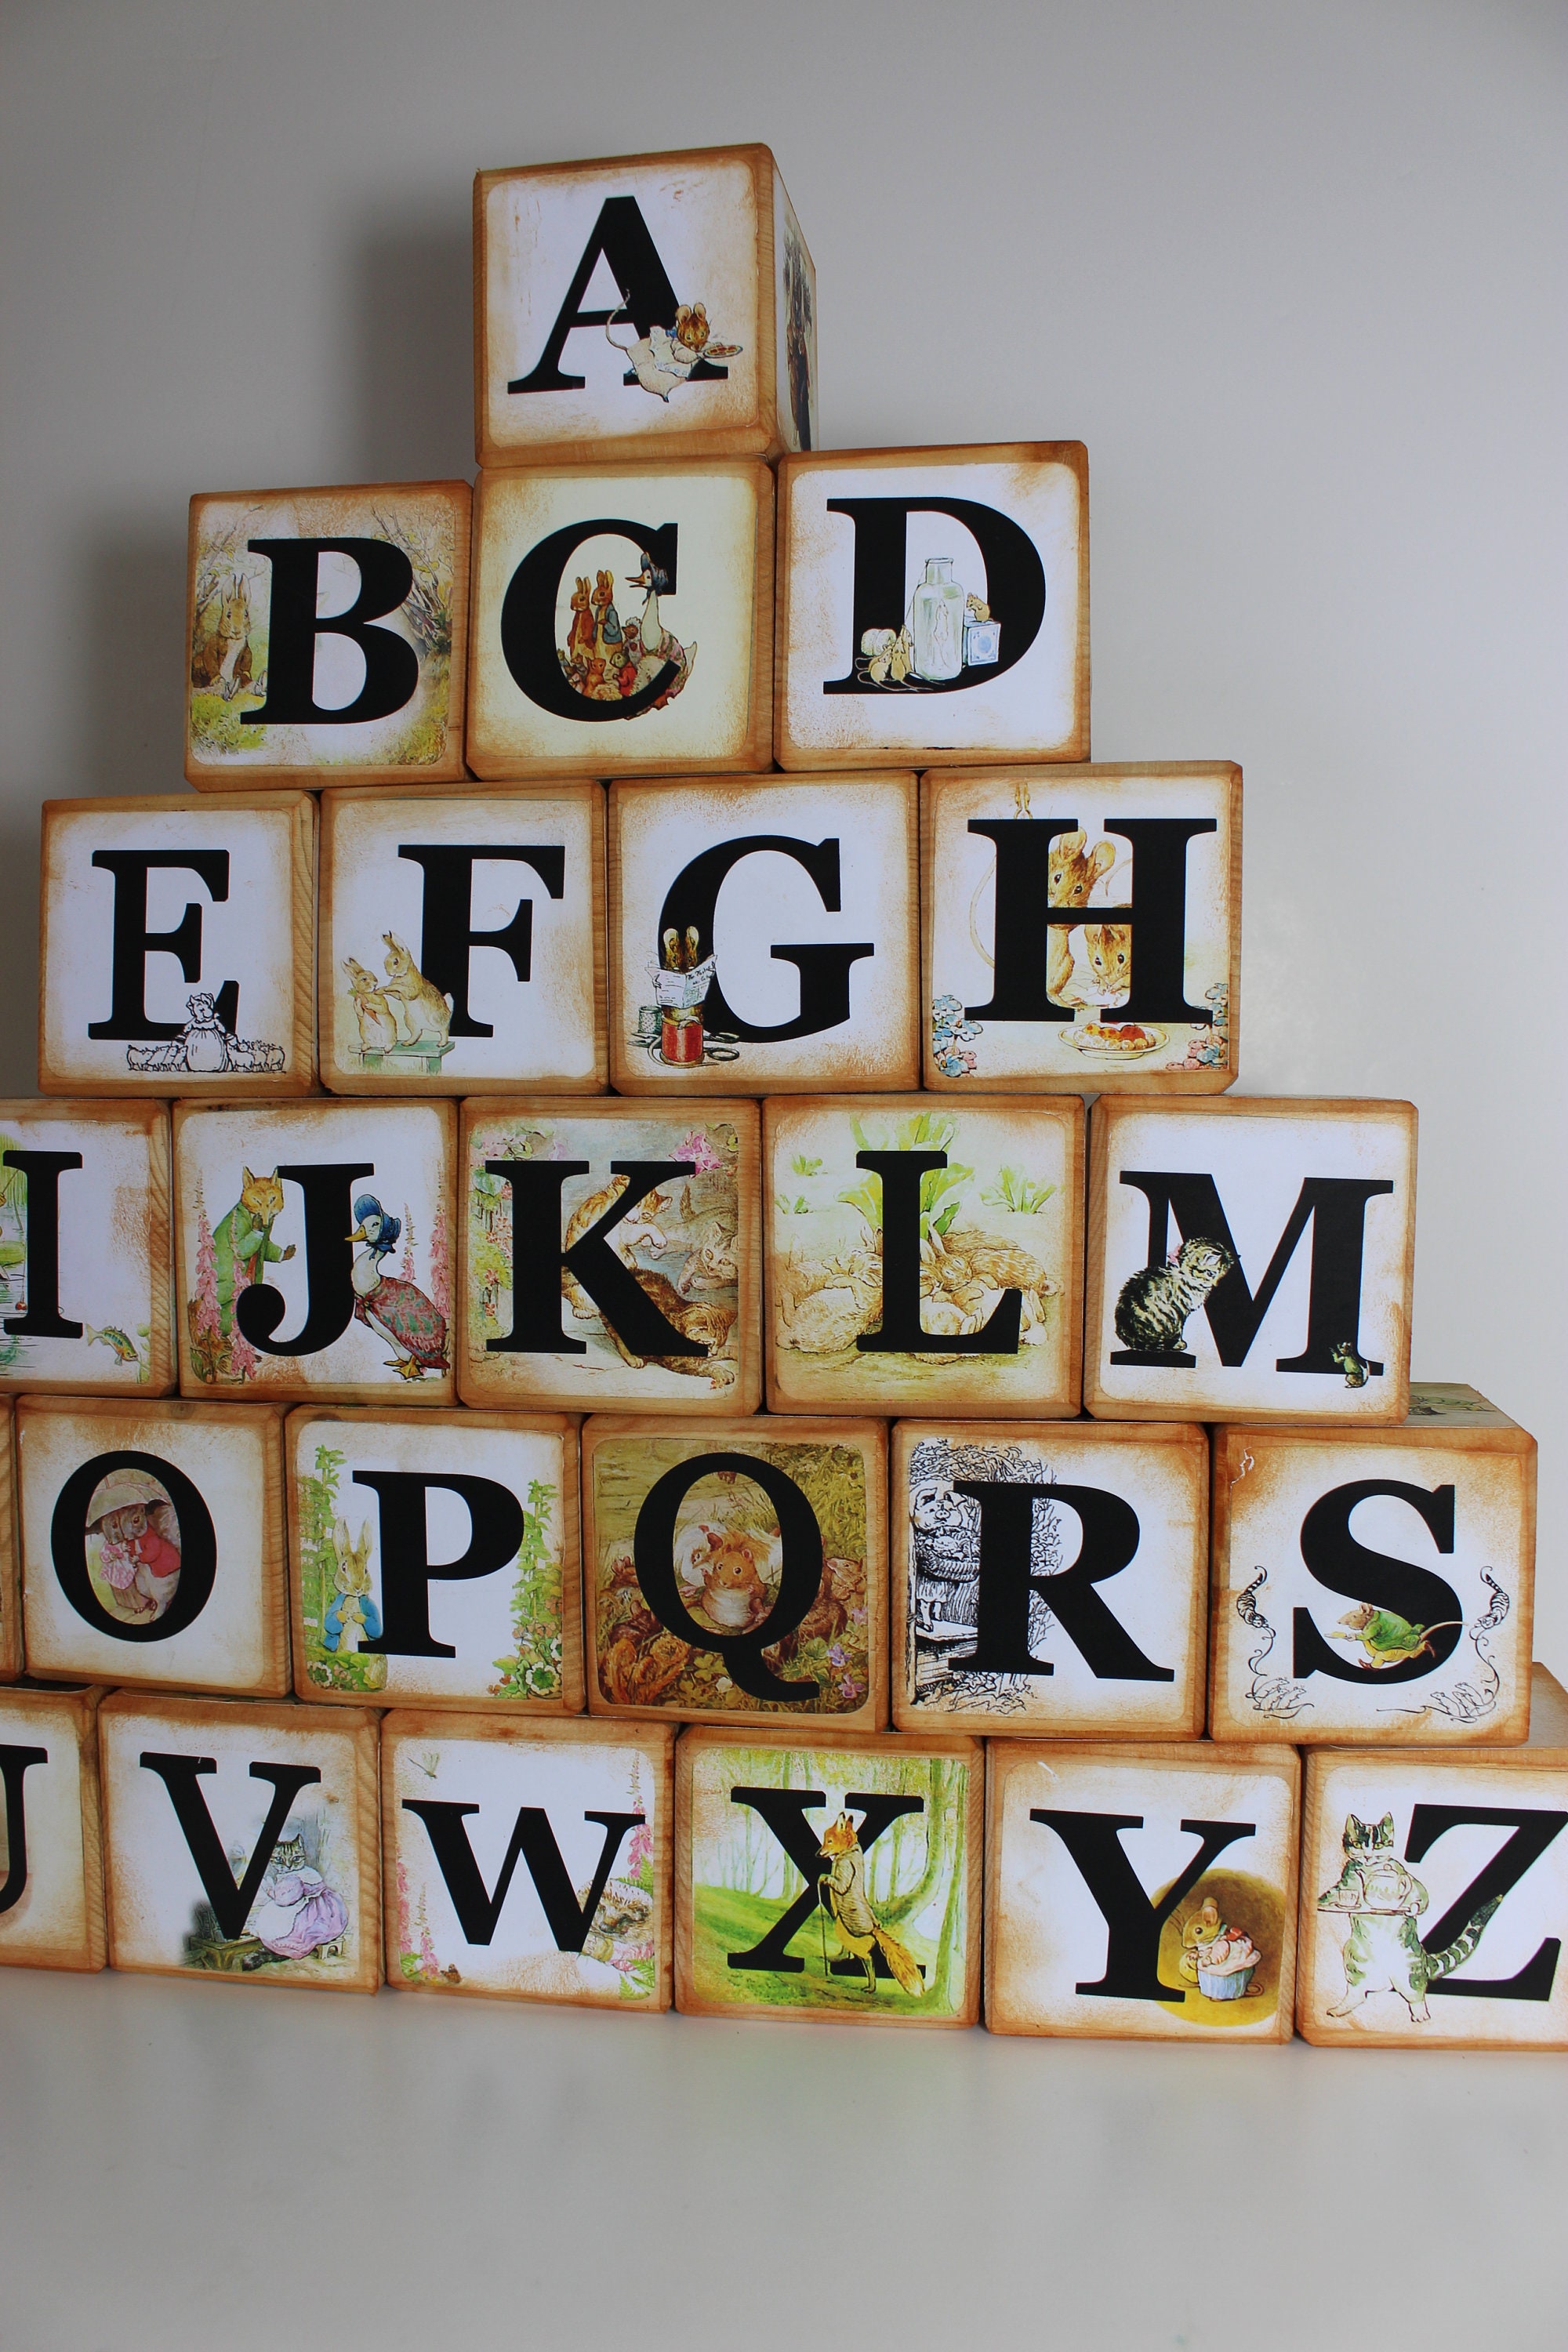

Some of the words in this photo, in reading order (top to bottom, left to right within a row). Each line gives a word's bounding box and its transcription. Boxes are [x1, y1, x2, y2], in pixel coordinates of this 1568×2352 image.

[507, 196, 728, 394] A
[240, 537, 419, 725] B
[501, 519, 681, 723] C
[823, 497, 1046, 695] D
[88, 849, 240, 1040] E
[398, 844, 565, 1038] F
[658, 835, 874, 1044] G
[964, 818, 1218, 1024] H
[2, 1149, 83, 1339] I
[236, 1163, 375, 1357] J
[485, 1160, 709, 1358] K
[856, 1150, 1023, 1355] L
[1110, 1171, 1394, 1377] M
[51, 1450, 216, 1642] O
[352, 1470, 525, 1658] P
[633, 1452, 822, 1702] Q
[948, 1479, 1174, 1682] R
[1293, 1479, 1464, 1685] S
[140, 1751, 321, 1940] V
[402, 1798, 646, 1953] W
[727, 1786, 926, 1980] X
[1029, 1808, 1256, 2002] Y
[1404, 1803, 1568, 2002] Z
